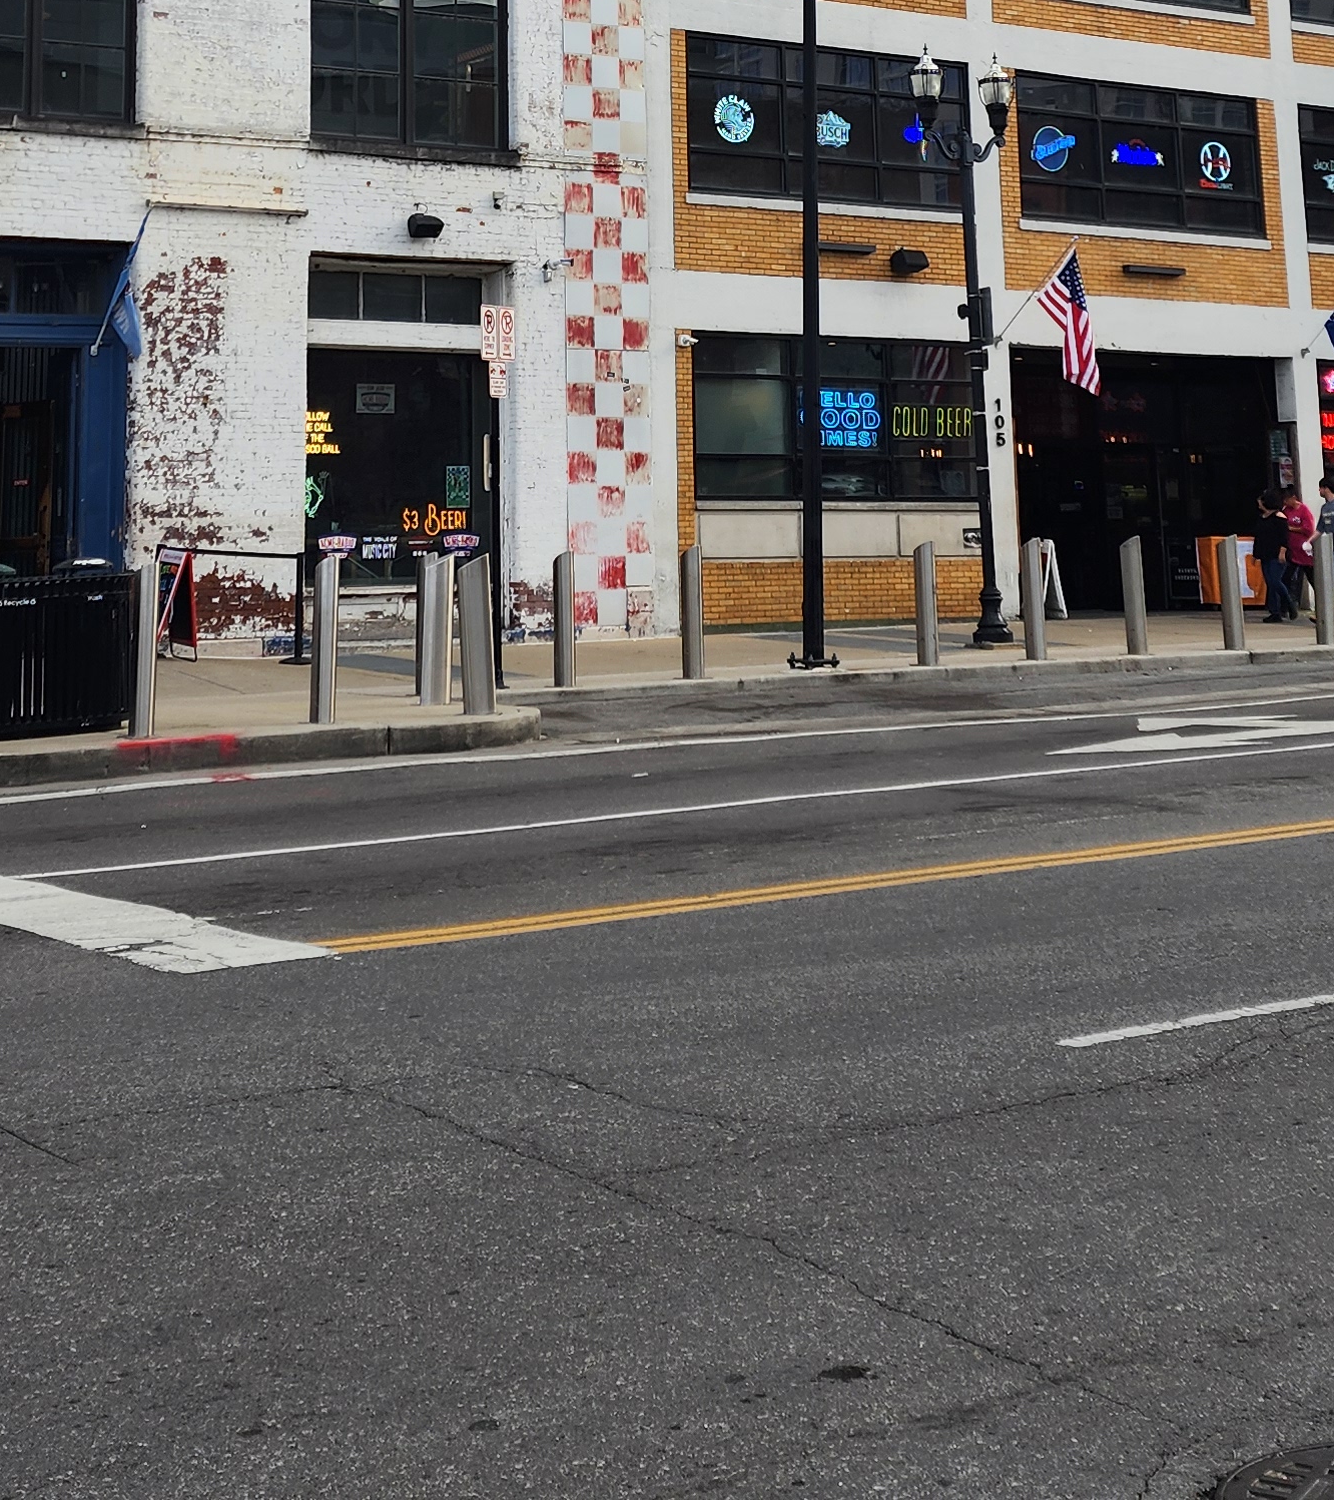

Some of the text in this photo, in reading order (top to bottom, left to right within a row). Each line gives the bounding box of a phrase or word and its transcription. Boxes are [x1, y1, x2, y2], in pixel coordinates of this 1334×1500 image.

[714, 94, 752, 124] WHITE CLAW
[814, 391, 875, 408] ELLO
[314, 421, 333, 432] CALL
[811, 408, 881, 429] OOD
[892, 406, 973, 438] COLD BEER
[994, 397, 1006, 447] 105
[310, 433, 325, 443] THE
[820, 429, 878, 448] IMES!
[322, 444, 341, 454] BALL
[402, 507, 419, 532] $3
